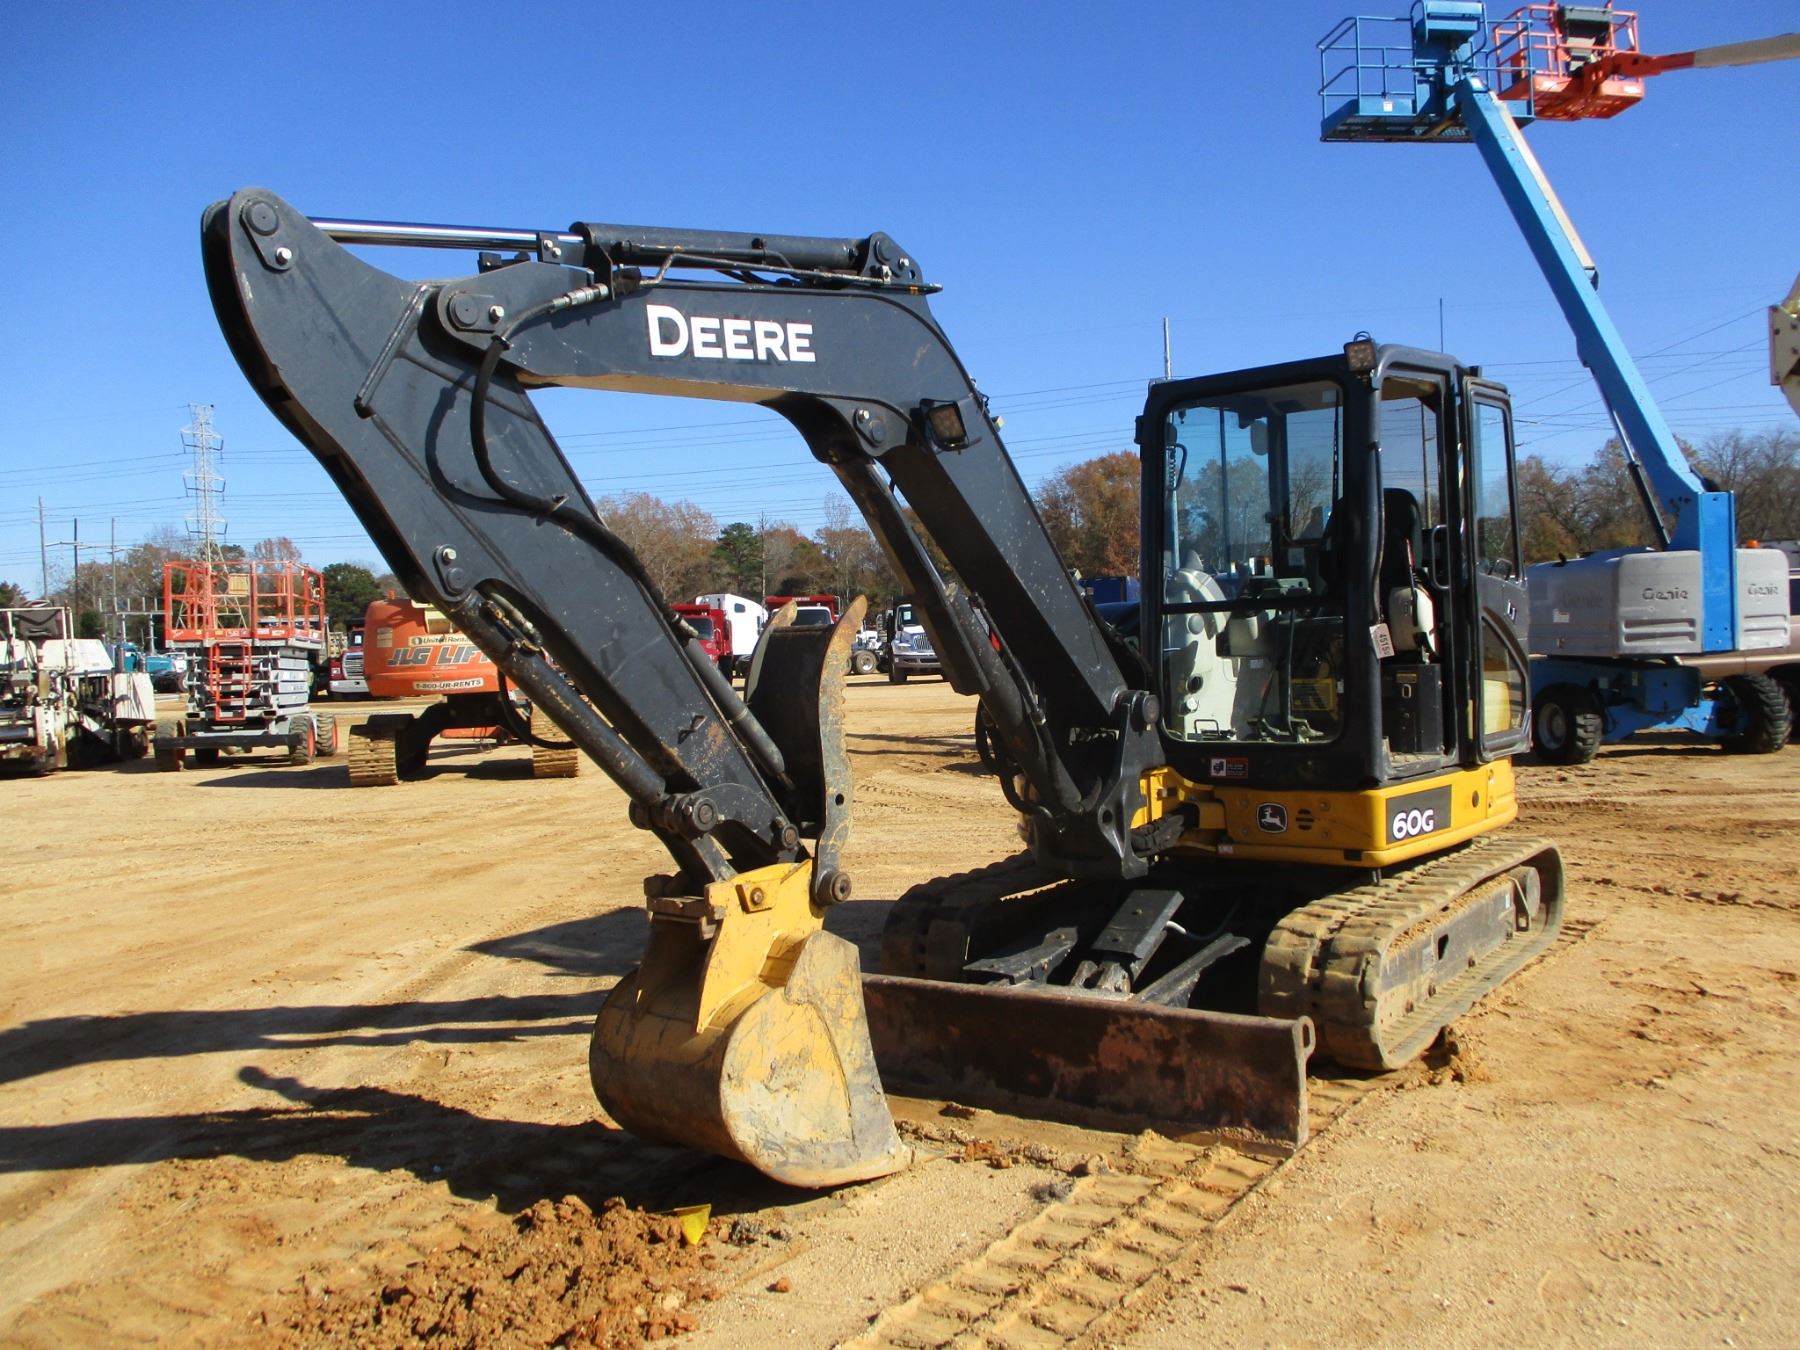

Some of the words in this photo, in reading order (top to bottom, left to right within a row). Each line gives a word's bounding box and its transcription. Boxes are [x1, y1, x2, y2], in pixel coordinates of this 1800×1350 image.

[646, 304, 816, 363] DEERE
[1642, 587, 1689, 600] Genie
[1747, 583, 1779, 595] Genie
[387, 647, 433, 666] JLG
[416, 680, 481, 689] 1-800-UR-RENTS
[1392, 808, 1435, 840] 60G
